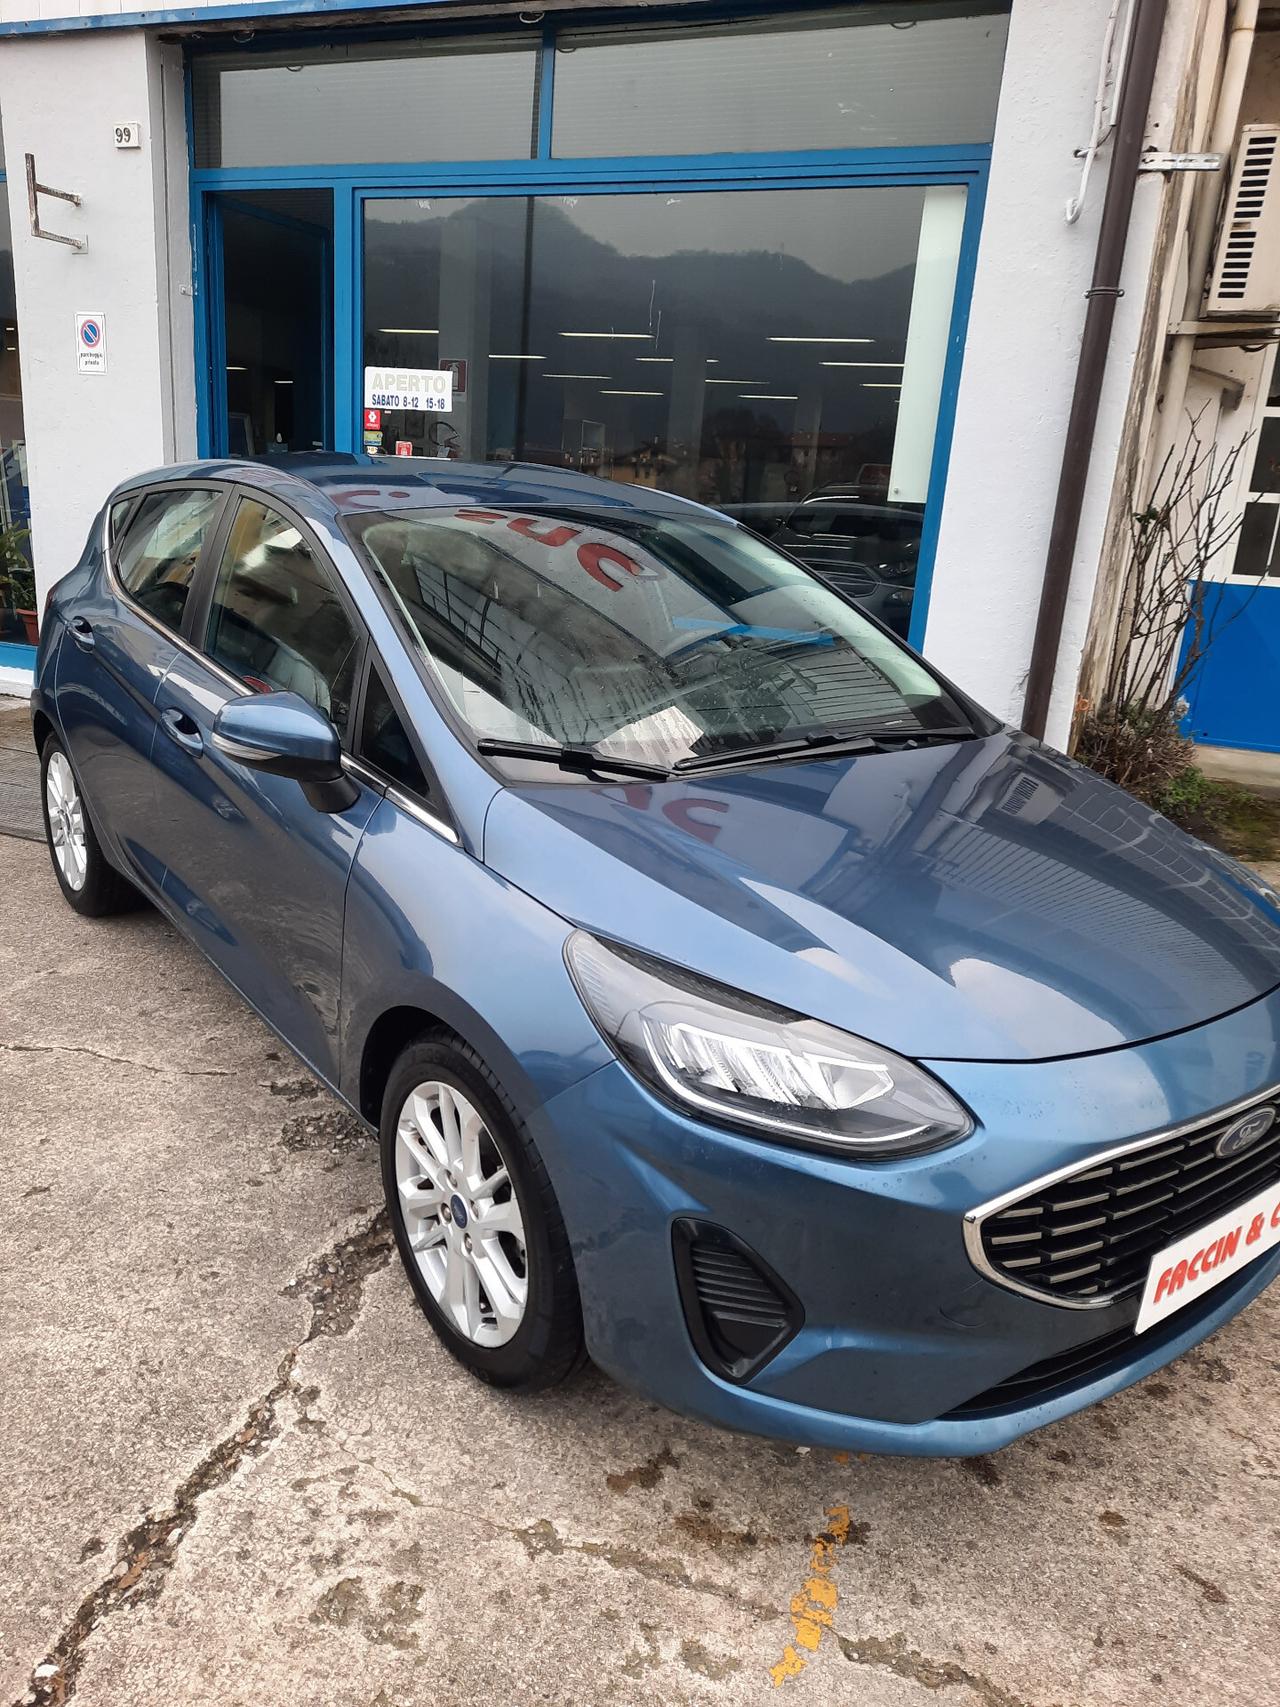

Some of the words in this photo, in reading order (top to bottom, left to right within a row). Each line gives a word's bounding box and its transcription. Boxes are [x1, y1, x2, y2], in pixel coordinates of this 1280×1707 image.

[115, 127, 131, 143] 99
[372, 373, 446, 393] APERTO
[371, 393, 400, 407] SABATO
[402, 396, 419, 408] 8-12
[426, 397, 446, 410] 15-18
[1152, 1225, 1243, 1305] FACCIN
[1245, 1211, 1265, 1246] &
